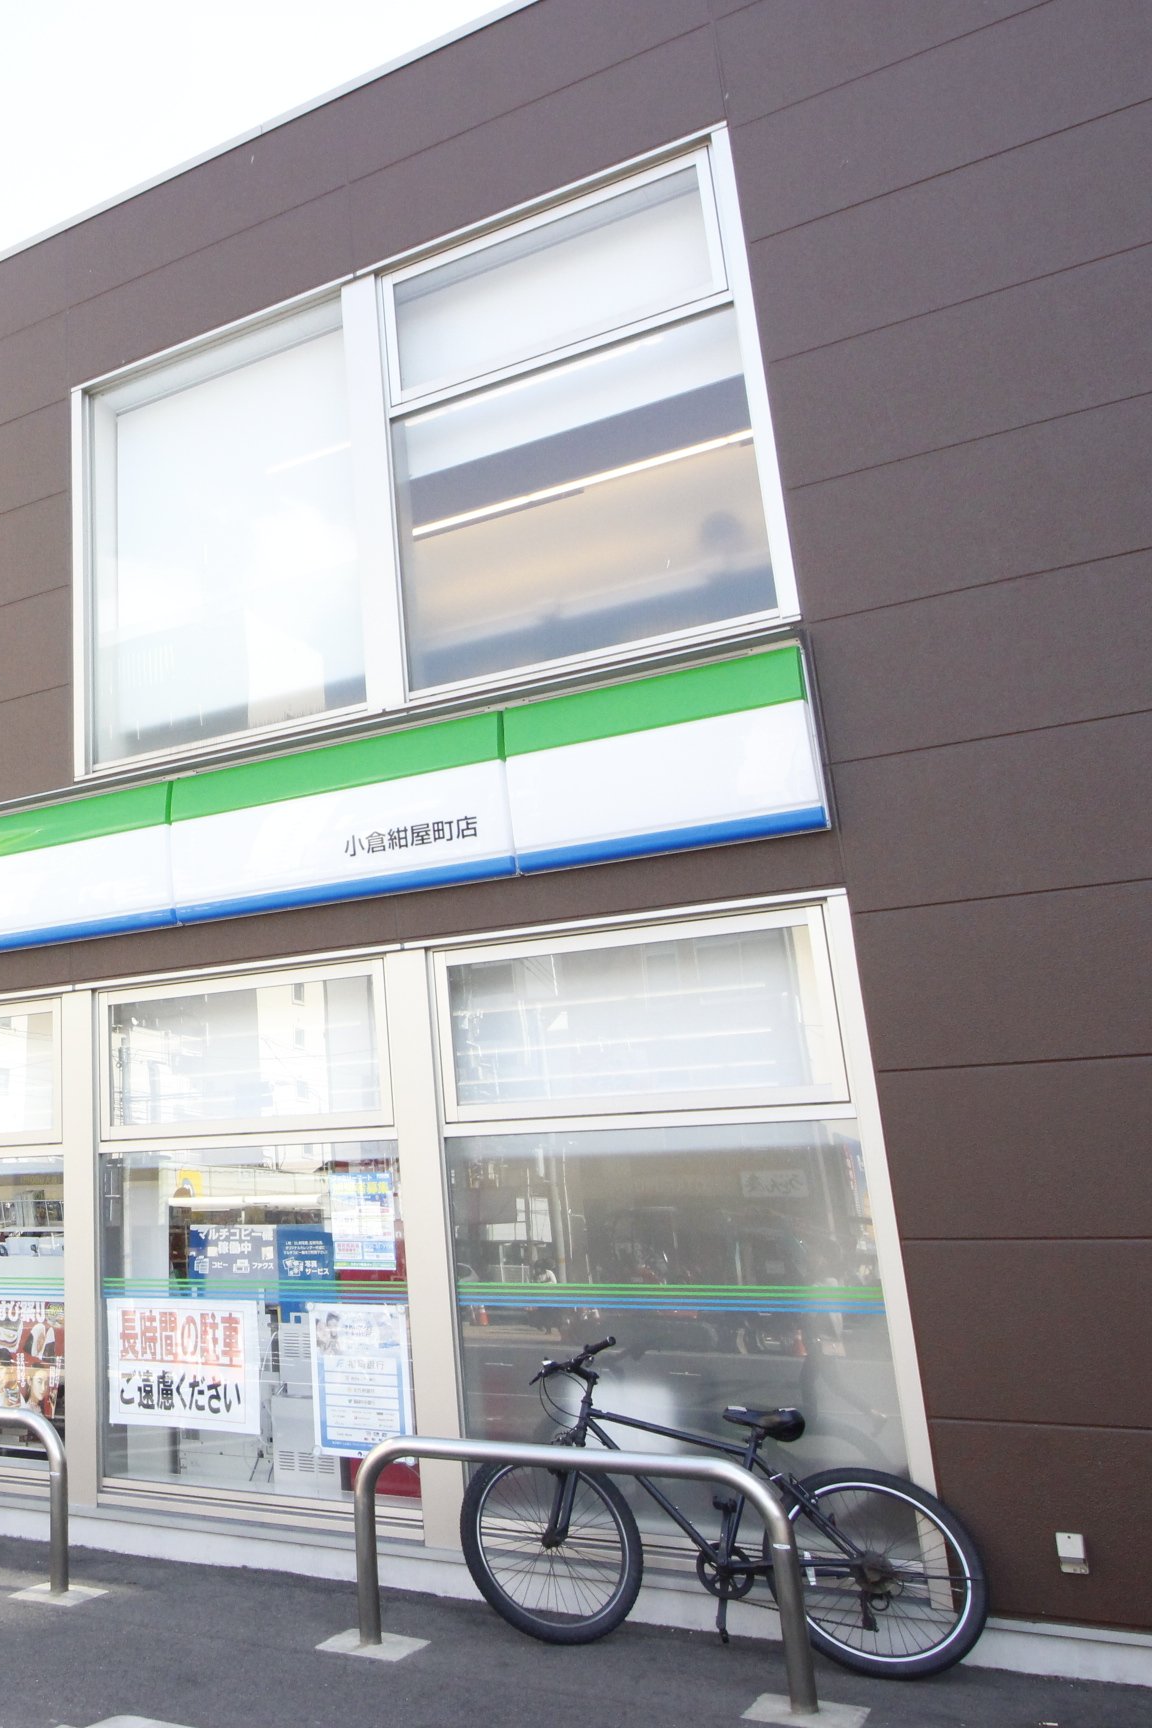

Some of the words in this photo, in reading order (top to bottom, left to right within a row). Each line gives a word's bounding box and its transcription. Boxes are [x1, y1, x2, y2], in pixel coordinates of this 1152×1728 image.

[345, 816, 478, 857] 小倉紺屋町店
[252, 1262, 274, 1270] ファクス
[119, 1309, 242, 1364] 長時間の駐車
[119, 1370, 242, 1415] ご遠慮ください
